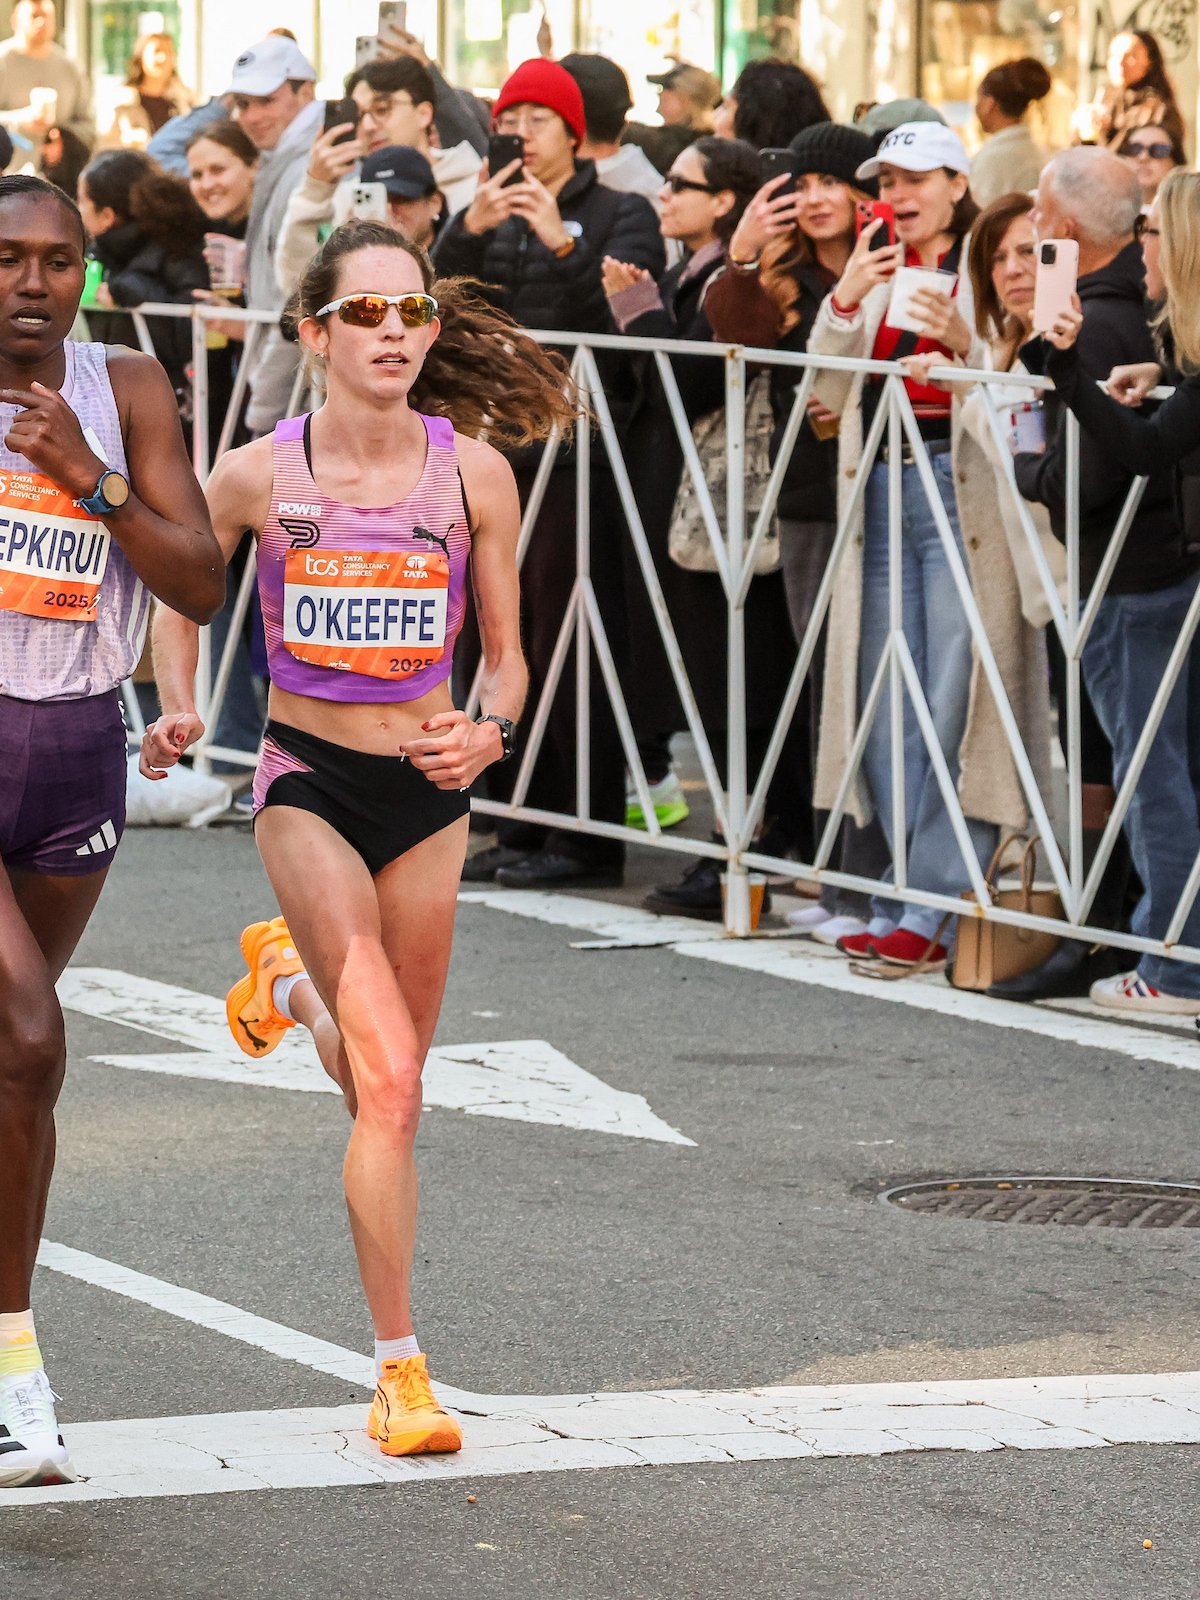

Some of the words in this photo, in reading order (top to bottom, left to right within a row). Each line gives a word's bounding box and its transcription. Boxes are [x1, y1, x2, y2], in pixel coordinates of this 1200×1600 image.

[12, 474, 33, 484] TATA
[8, 489, 41, 501] SERVICES
[9, 481, 61, 497] CONSULTANCY
[305, 553, 340, 577] tcs
[342, 562, 391, 571] CONSULTANCY
[402, 570, 429, 579] TATA
[43, 591, 89, 608] 2025
[295, 595, 436, 641] O'KEEFFE
